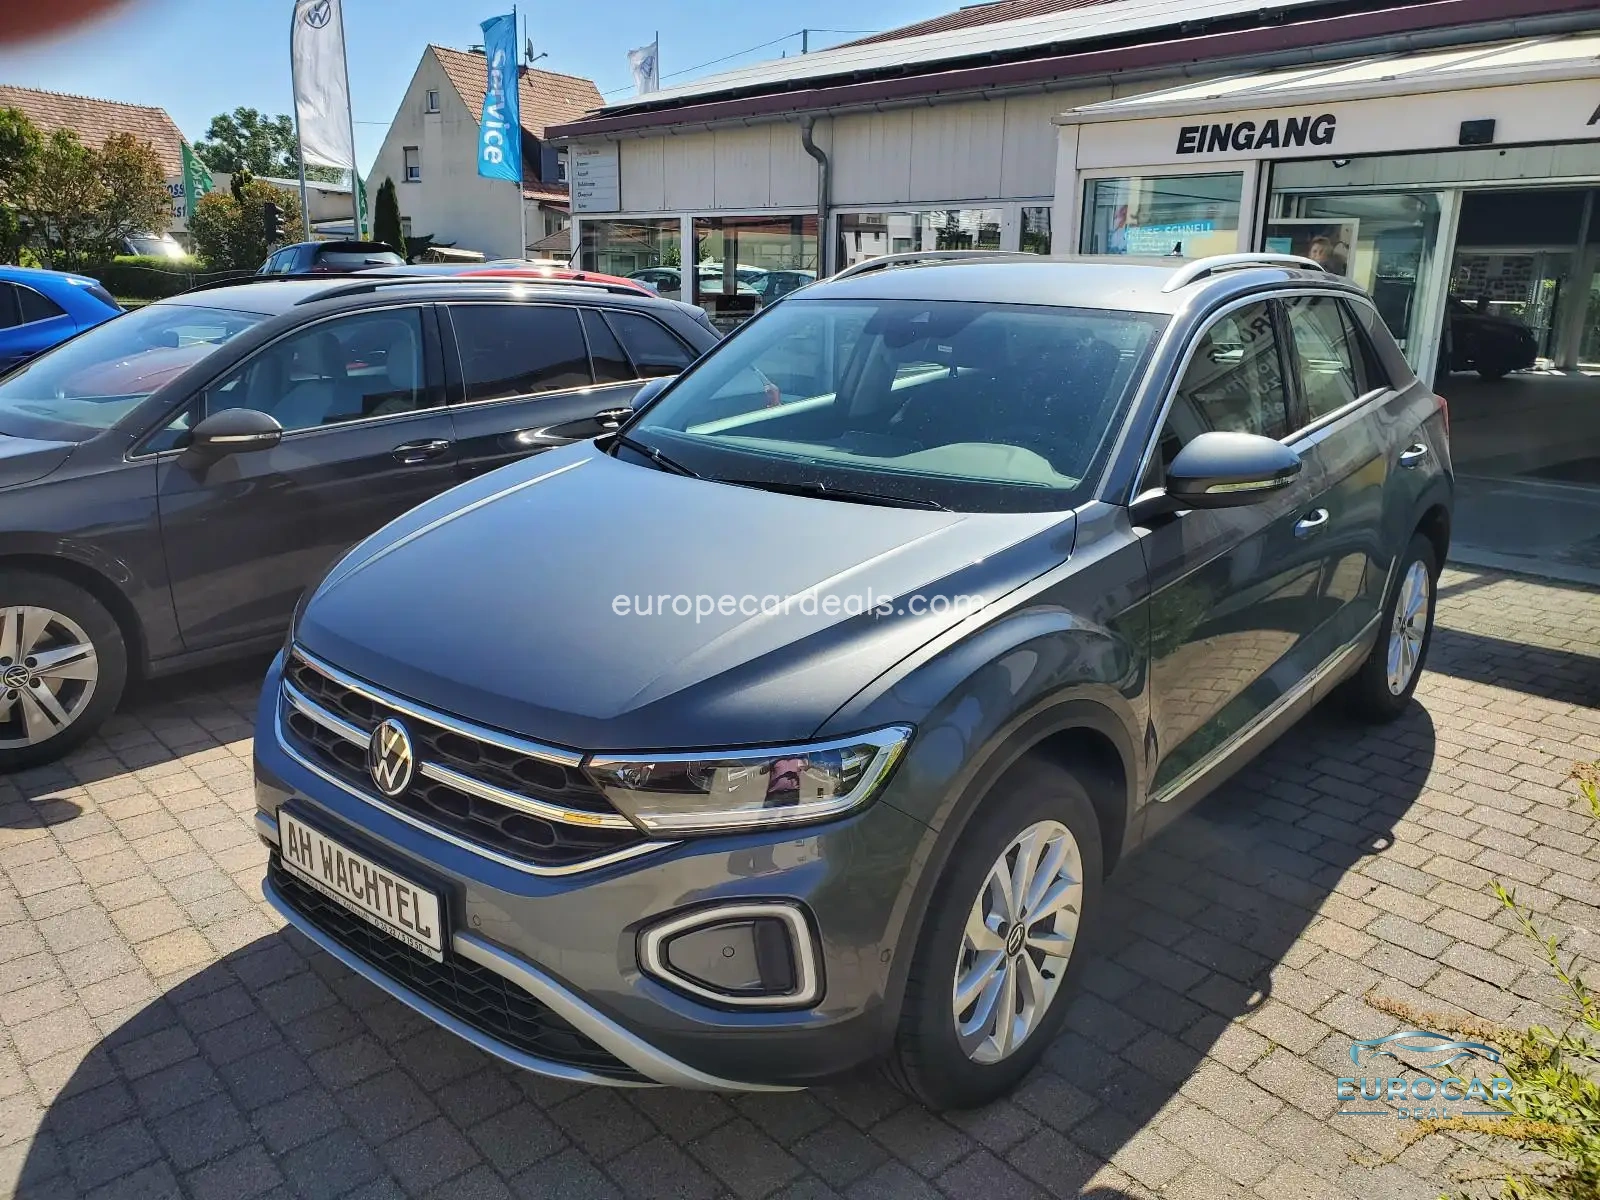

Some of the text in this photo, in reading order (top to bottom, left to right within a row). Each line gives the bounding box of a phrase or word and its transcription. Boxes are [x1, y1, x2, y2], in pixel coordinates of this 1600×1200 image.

[1176, 114, 1336, 154] EINGANG
[190, 161, 205, 199] DEKR
[288, 821, 431, 939] AH WACHTEL
